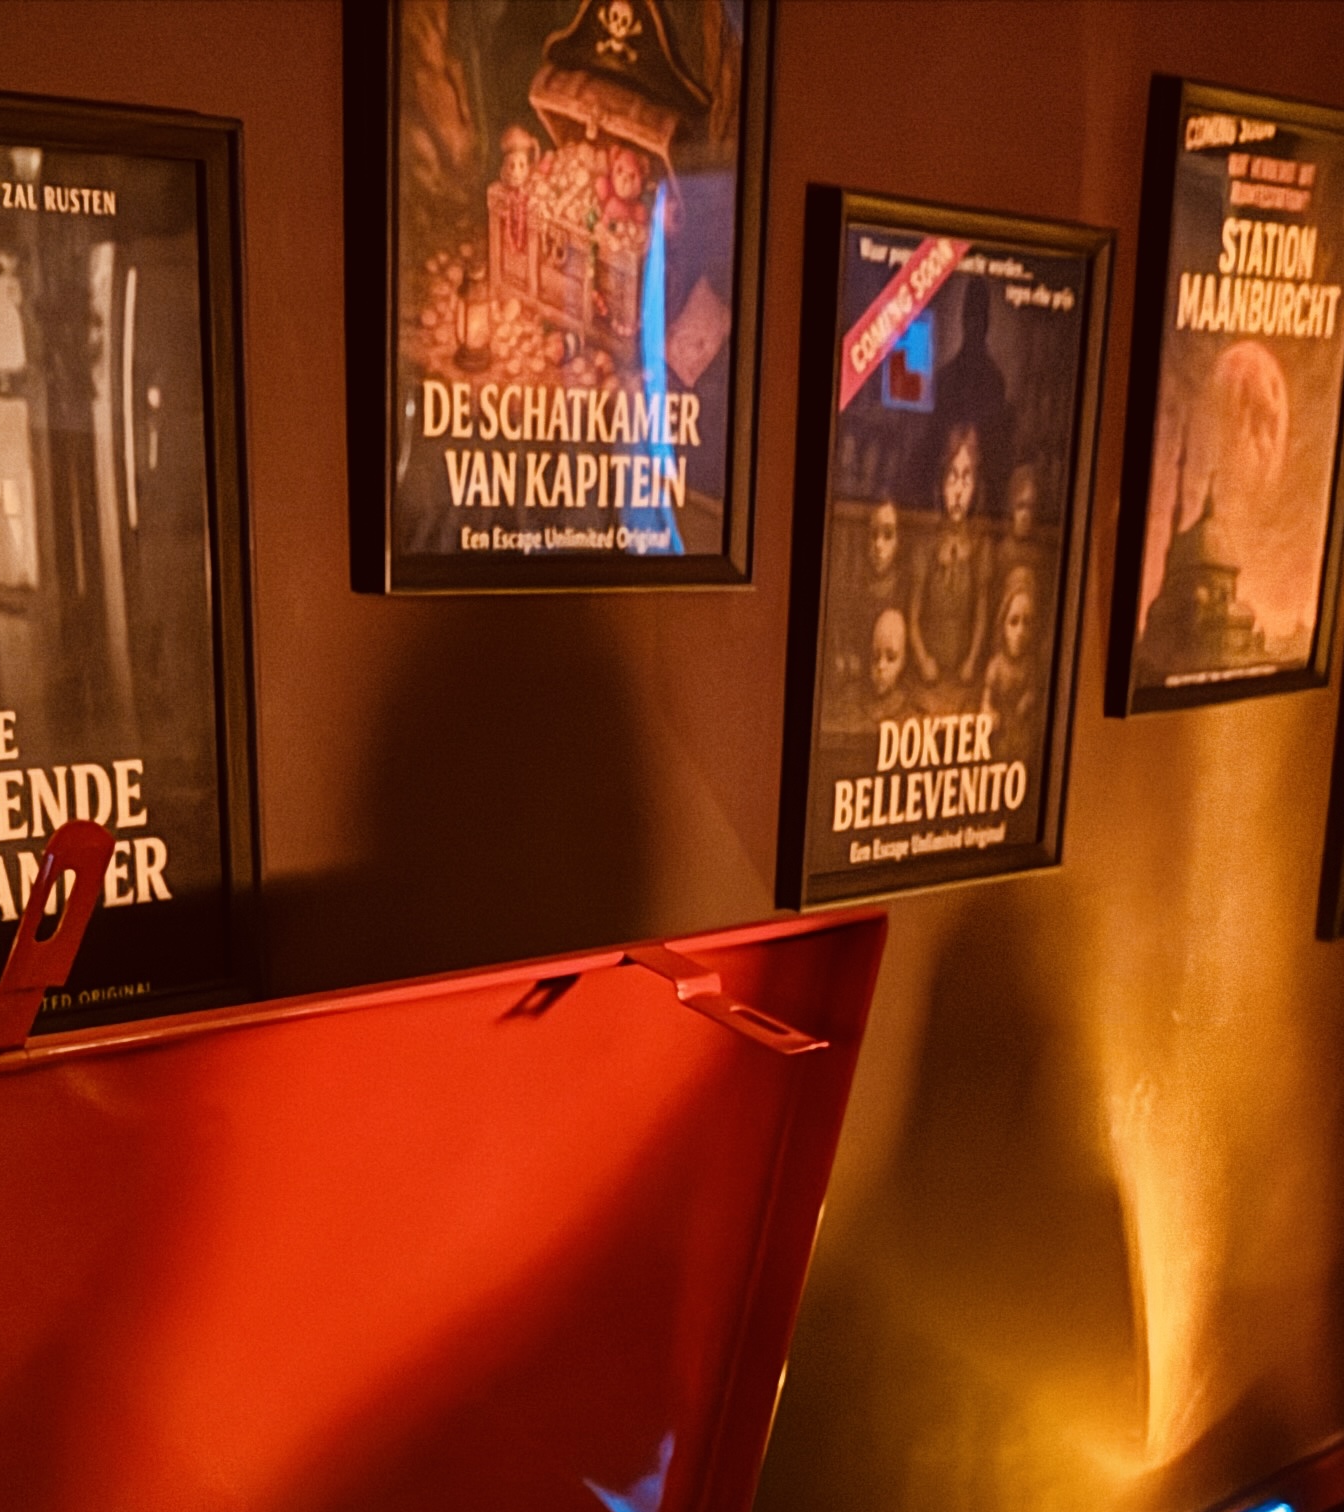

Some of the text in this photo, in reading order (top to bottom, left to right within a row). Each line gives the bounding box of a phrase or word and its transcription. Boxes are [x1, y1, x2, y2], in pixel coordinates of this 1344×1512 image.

[2, 182, 38, 211] ZAL
[44, 186, 117, 216] RUSTEN
[1219, 216, 1318, 280] STATION
[850, 282, 913, 373] COMING
[910, 238, 955, 300] SOON
[1176, 271, 1342, 340] MAANBURCHT
[423, 380, 701, 447] DE SCHATKAMER
[444, 449, 687, 508] VAN KAPITEIN
[461, 526, 671, 555] Een Escape Unlimited Original
[877, 713, 994, 772] DOKTER
[833, 761, 1027, 833] BELLEVENITO
